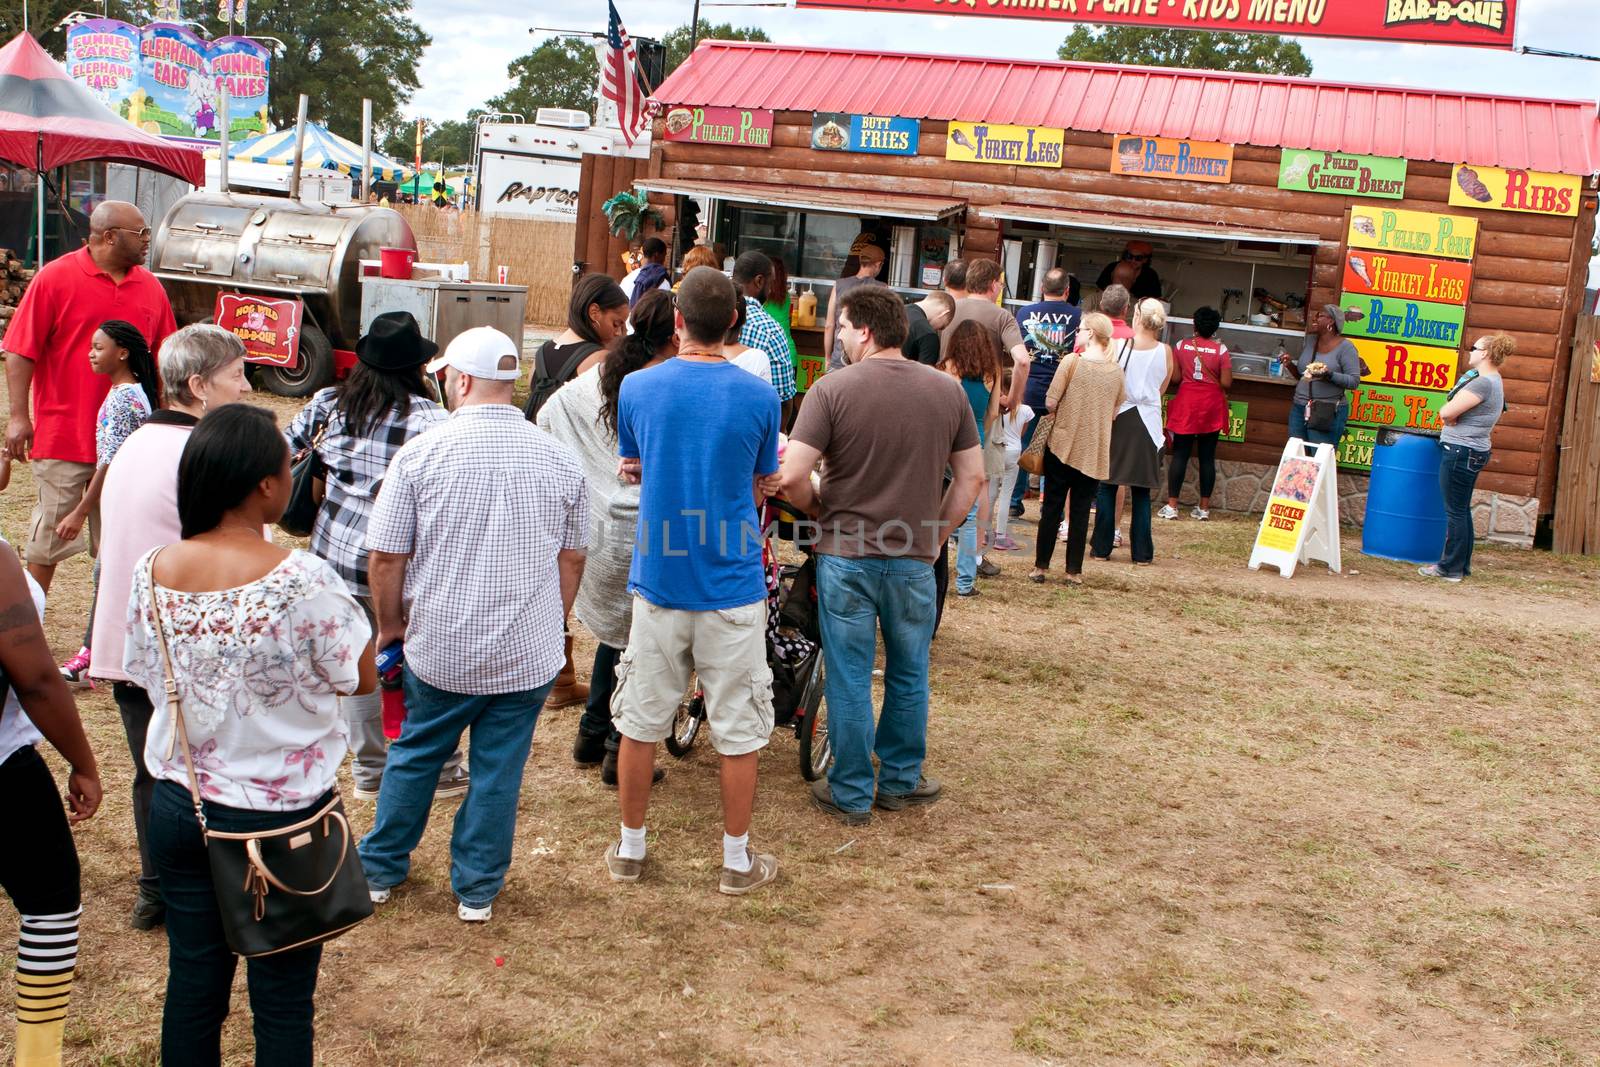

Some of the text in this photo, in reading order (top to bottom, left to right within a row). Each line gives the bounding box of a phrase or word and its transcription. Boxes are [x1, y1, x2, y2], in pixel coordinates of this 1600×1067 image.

[1247, 0, 1325, 24] MENU
[1386, 0, 1504, 30] BAR-B-QUE
[72, 33, 132, 49] FUNNEL
[75, 46, 130, 61] CAKES
[141, 37, 206, 74] ELEPHANT
[72, 61, 133, 80] ELEPHANT
[211, 53, 268, 76] FUNNEL
[86, 74, 118, 89] EARS
[154, 62, 188, 89] EARS
[215, 76, 266, 97] CAKES
[861, 116, 892, 130] BUTT
[859, 130, 910, 150] FRIES
[1501, 169, 1573, 213] RIBS
[235, 304, 279, 321] HOG WILD
[1030, 311, 1073, 325] NAVY
[1193, 355, 1203, 380] 1
[1381, 345, 1450, 389] RIBS
[1268, 515, 1296, 532] FRIES
